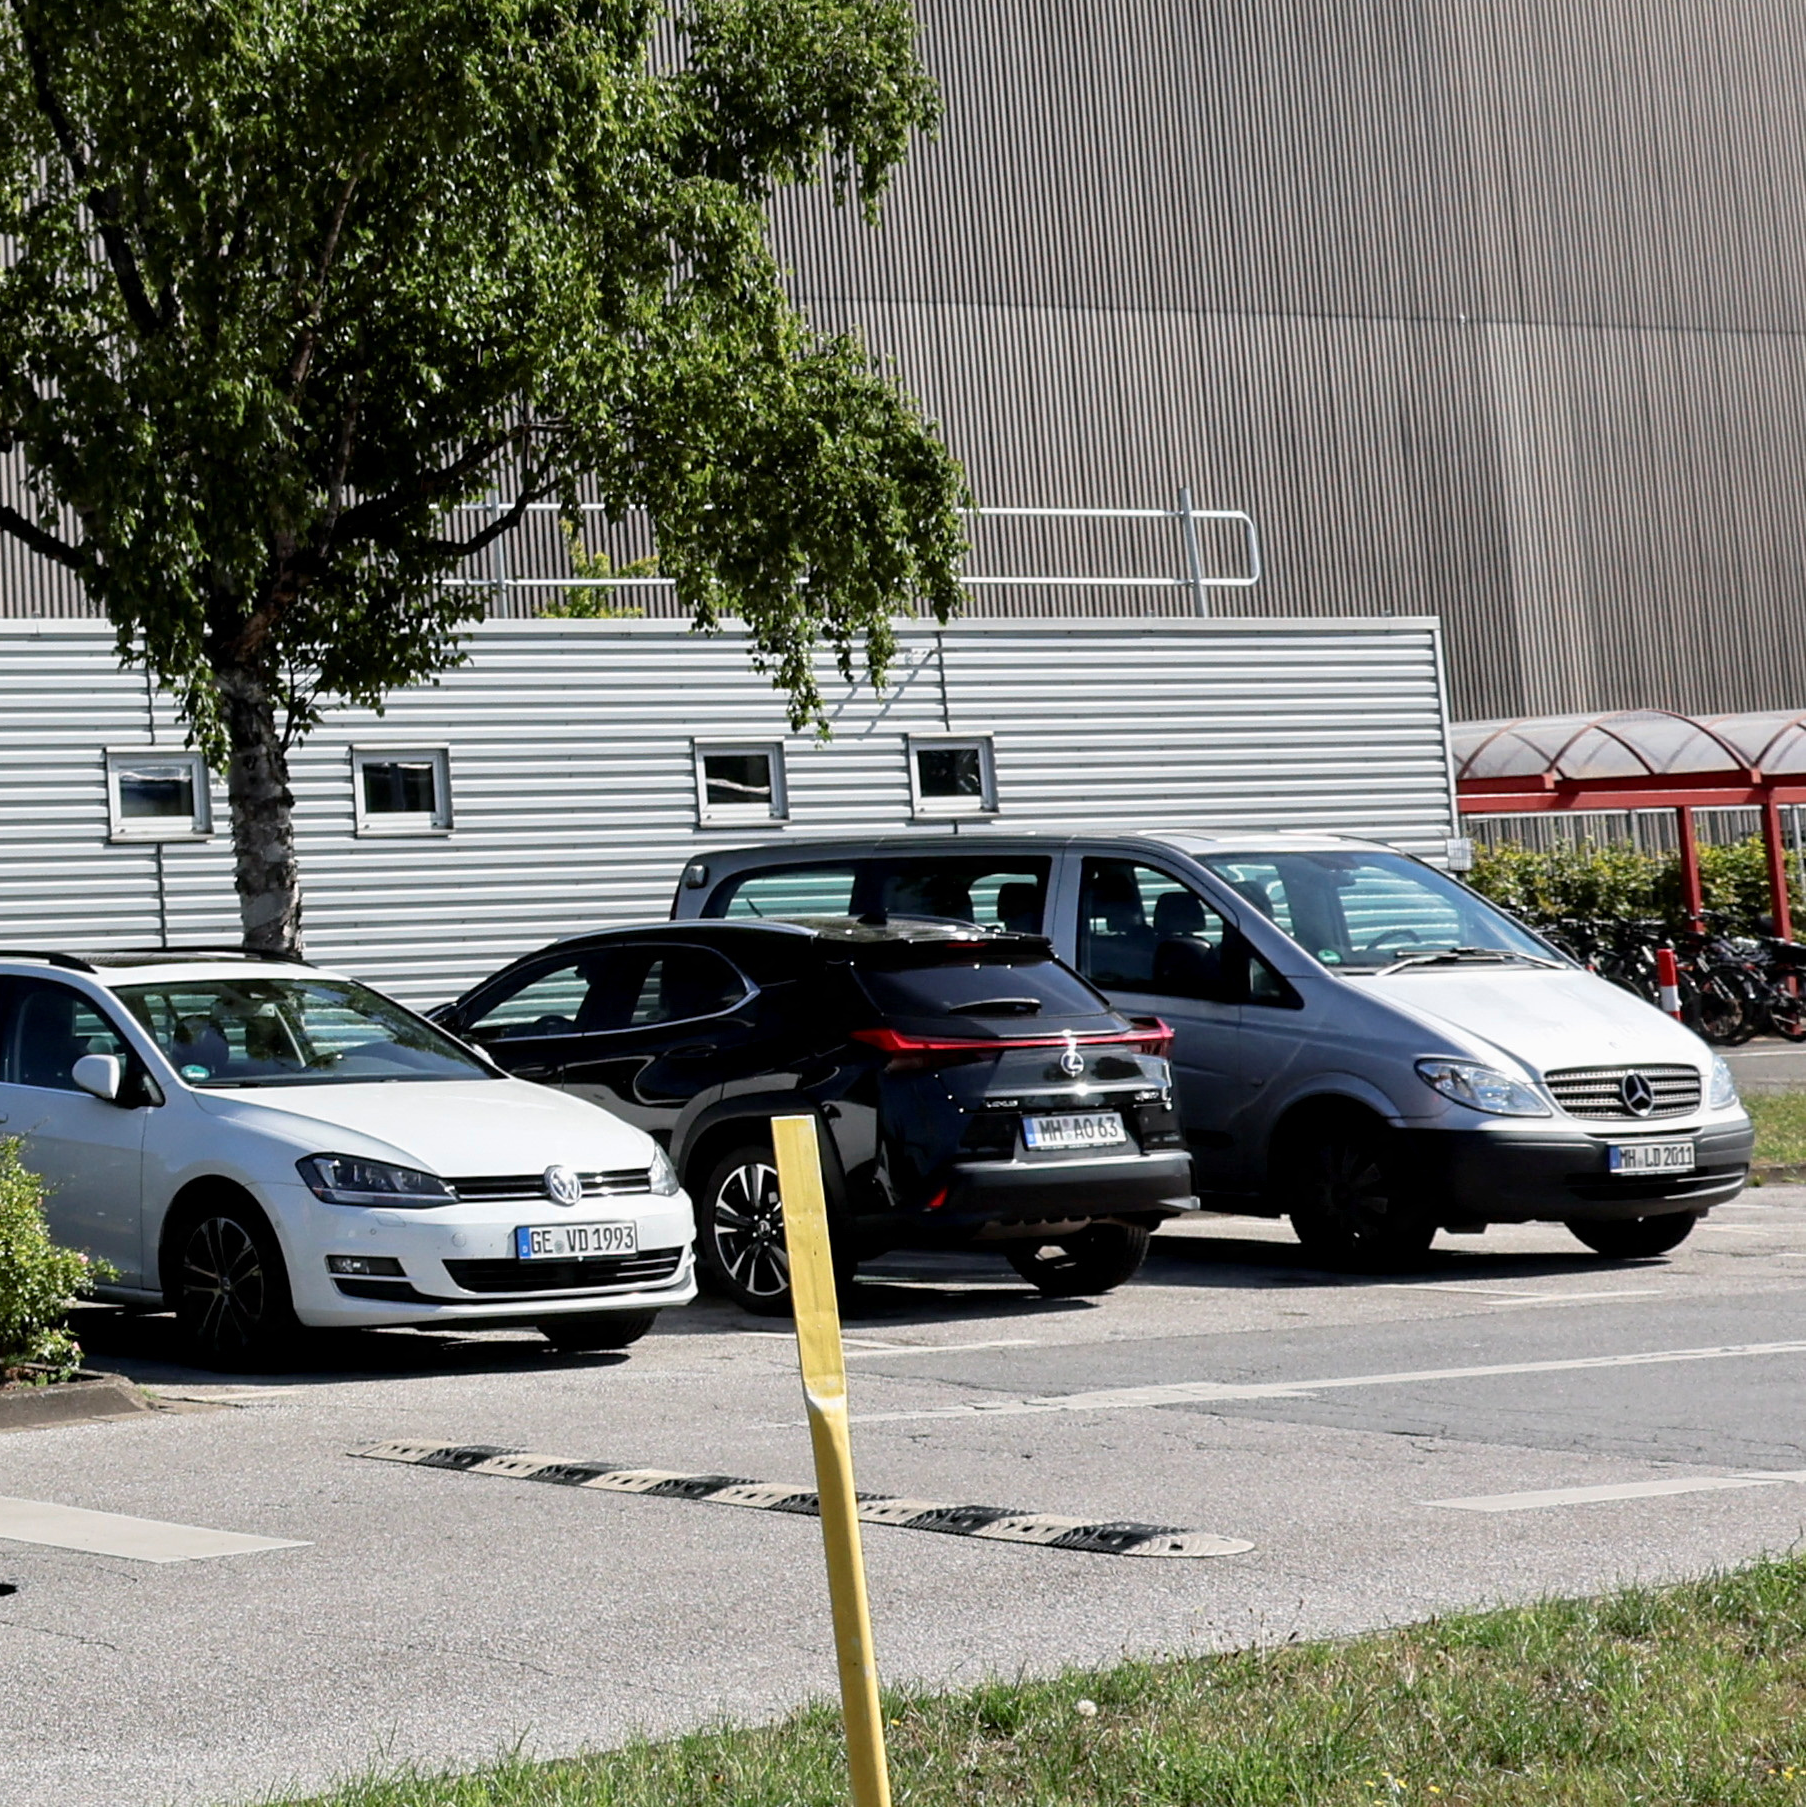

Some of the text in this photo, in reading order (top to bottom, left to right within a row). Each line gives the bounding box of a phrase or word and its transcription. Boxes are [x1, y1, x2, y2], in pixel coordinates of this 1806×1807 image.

[1039, 1116, 1118, 1142] MH AO 63
[1620, 1148, 1636, 1168] MH
[1664, 1146, 1693, 1167] 2011
[530, 1230, 553, 1254] GE
[566, 1228, 589, 1252] VD
[592, 1226, 634, 1251] 1993
